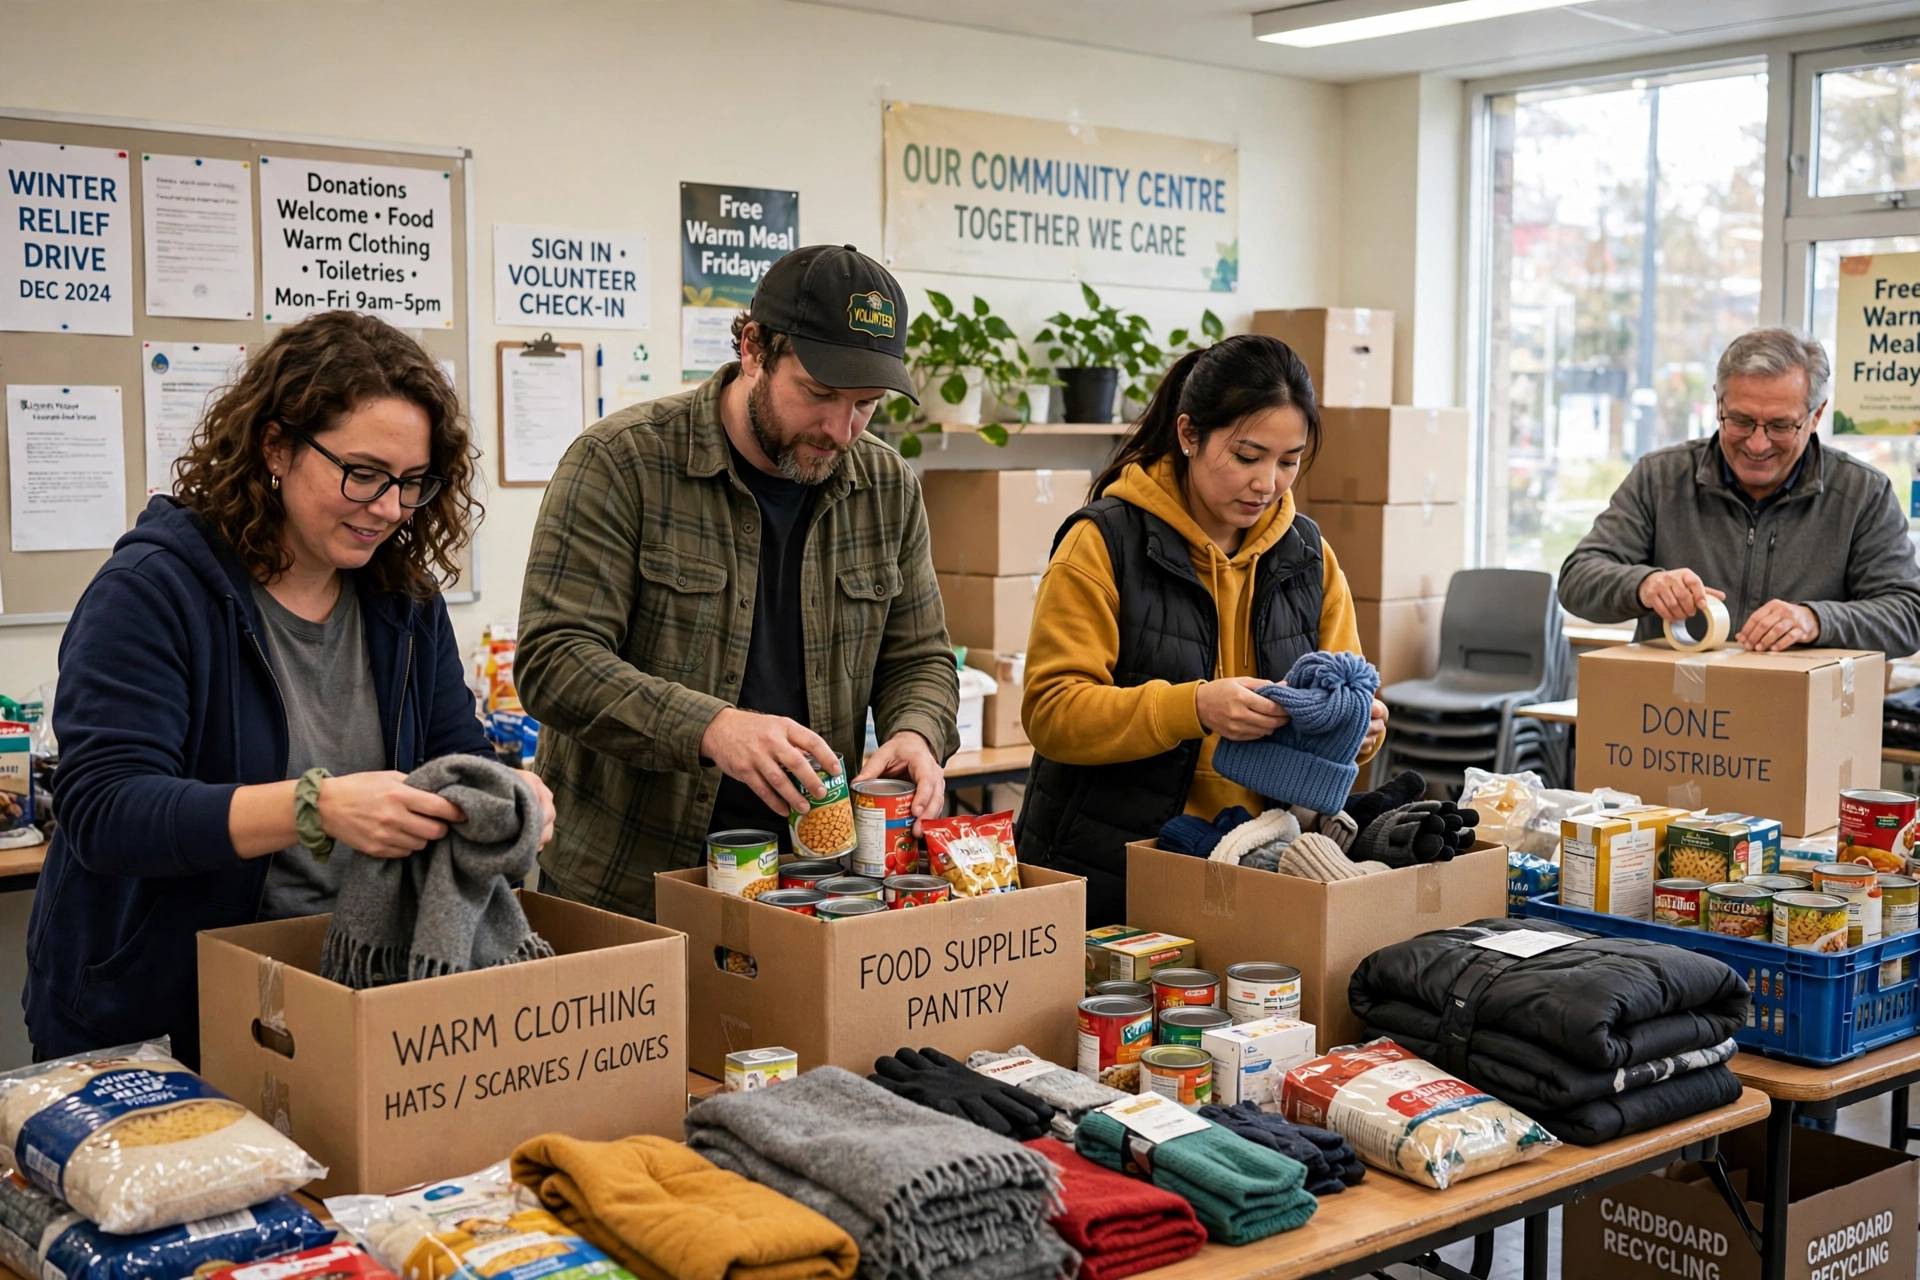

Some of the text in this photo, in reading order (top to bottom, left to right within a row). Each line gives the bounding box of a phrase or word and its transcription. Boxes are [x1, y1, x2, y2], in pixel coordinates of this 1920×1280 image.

[8, 169, 117, 202] WINTER
[307, 172, 407, 199] Donations
[903, 142, 1226, 213] OUR COMMUNITY CENTRE
[18, 206, 110, 236] RELIEF
[277, 199, 434, 228] Welcome Food
[719, 194, 763, 220] Free
[283, 228, 430, 261] Warm Clothing
[686, 219, 794, 250] Warm Meal
[954, 204, 1186, 257] TOGETHER WE CARE
[24, 242, 107, 272] DRIVE
[531, 238, 612, 262] SIGN IN
[315, 259, 405, 283] Toiletries
[508, 264, 636, 292] VOLUNTEER
[19, 279, 112, 303] DEC 2024
[1875, 278, 1920, 299] Free
[519, 292, 625, 318] CHECK-IN
[1869, 332, 1920, 354] Meal
[1642, 703, 1730, 741] DONE
[1605, 743, 1771, 782] TO DISTRIBUTE
[860, 923, 1057, 990] FOOD SUPPLIES
[908, 980, 1009, 1030] PANTRY
[392, 983, 656, 1066] WARM CLOTHING
[385, 1082, 446, 1121] HATS
[475, 1057, 570, 1100] SCARVES
[594, 1034, 669, 1073] GLOVES
[1600, 1198, 1728, 1257] CARDBOARD
[1807, 1210, 1893, 1265] CARDBOARD
[1603, 1228, 1720, 1280] RECYCLING
